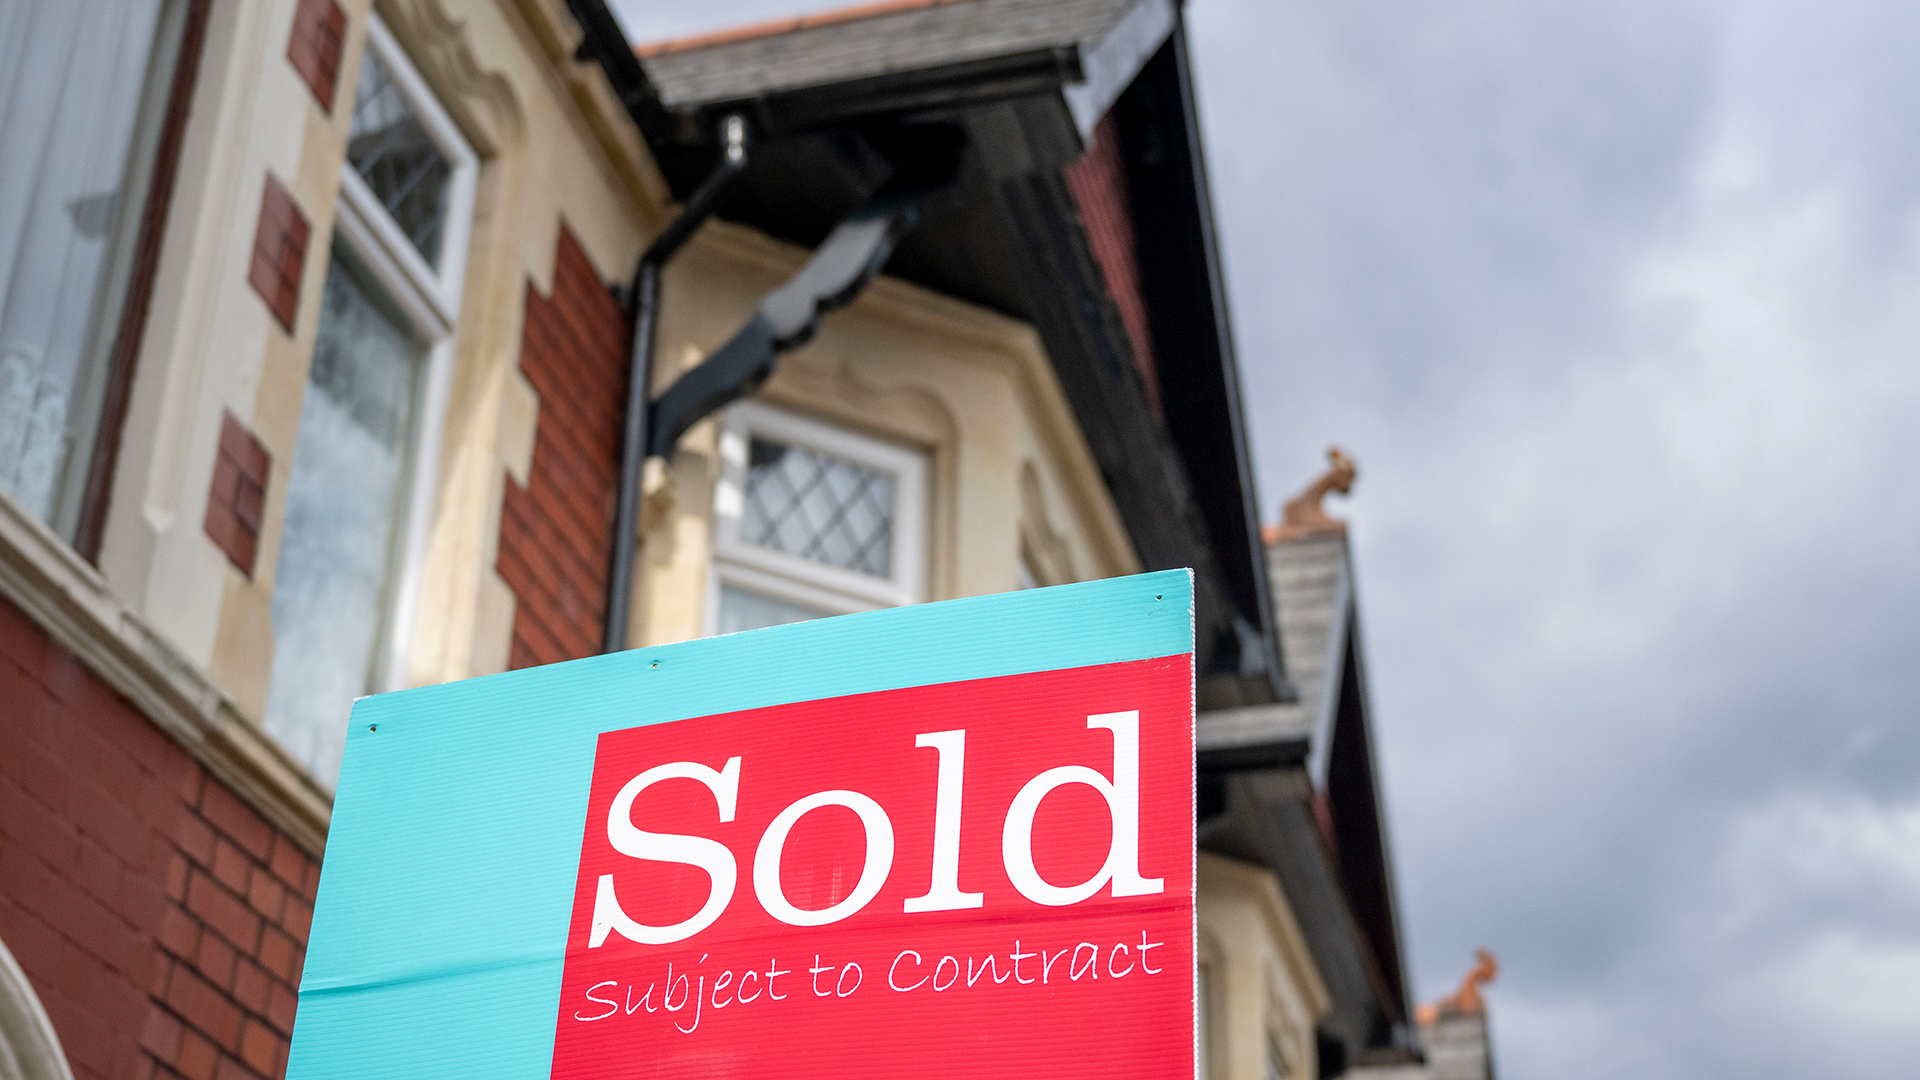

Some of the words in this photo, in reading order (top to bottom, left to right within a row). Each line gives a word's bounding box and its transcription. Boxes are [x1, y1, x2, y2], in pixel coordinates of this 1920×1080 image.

[588, 709, 1165, 949] Sold
[574, 953, 791, 1034] Subject
[809, 954, 864, 998] to
[888, 929, 1164, 992] Contract
